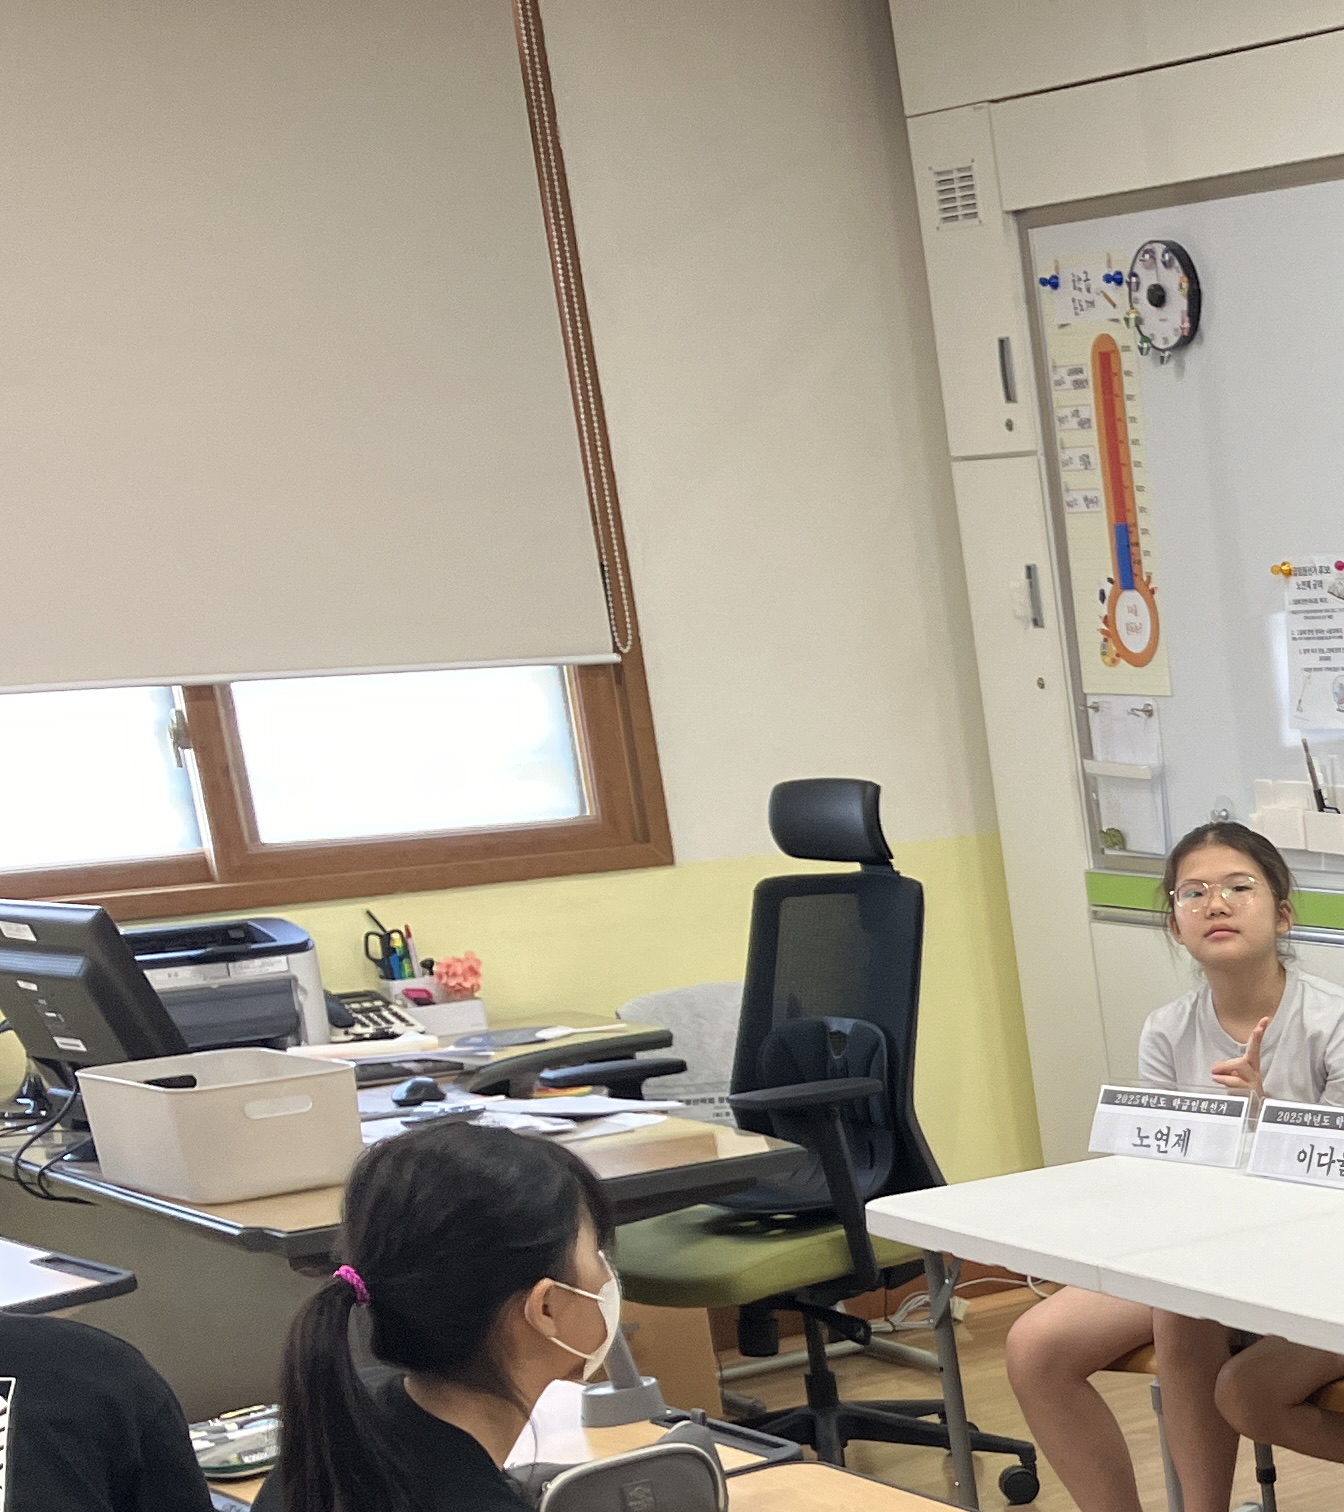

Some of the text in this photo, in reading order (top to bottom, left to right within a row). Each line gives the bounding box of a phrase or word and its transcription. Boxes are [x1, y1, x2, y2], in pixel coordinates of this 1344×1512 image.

[1113, 1092, 1229, 1116] 2025학년도 학급임원선거
[1276, 1109, 1331, 1130] 2025학년도
[1131, 1126, 1193, 1158] 노연제
